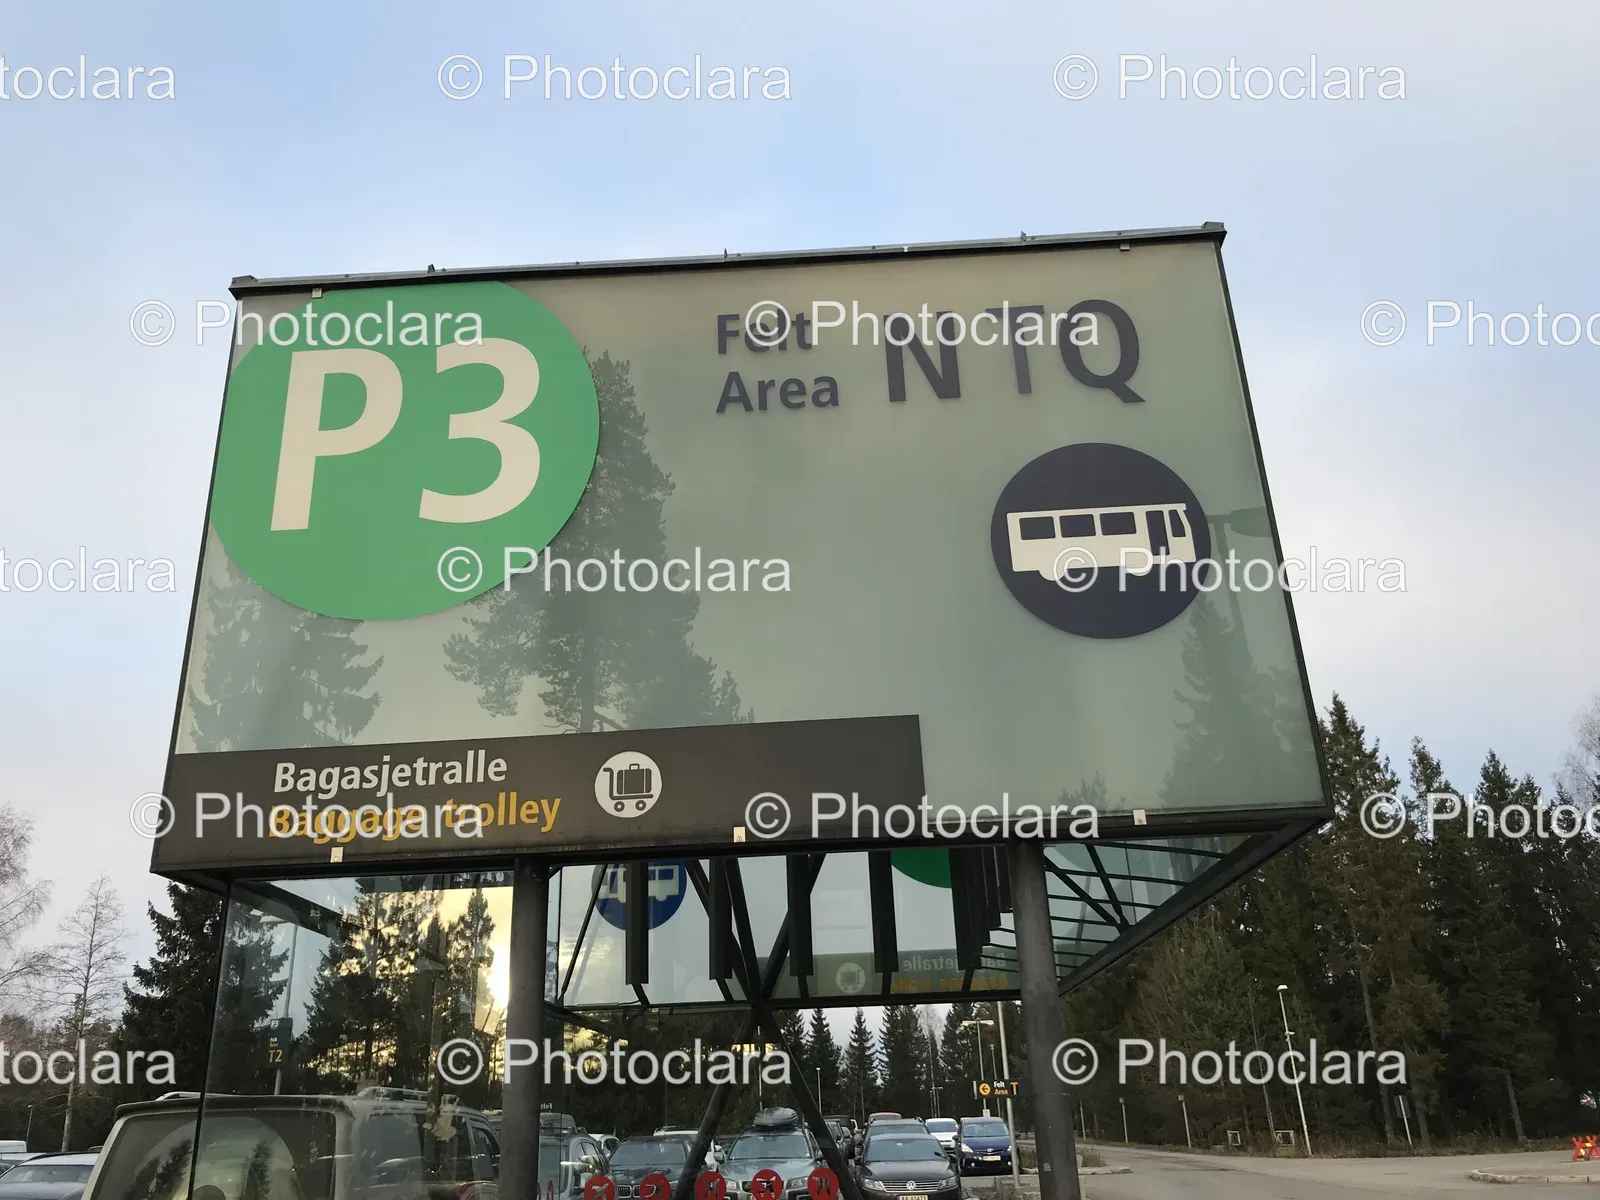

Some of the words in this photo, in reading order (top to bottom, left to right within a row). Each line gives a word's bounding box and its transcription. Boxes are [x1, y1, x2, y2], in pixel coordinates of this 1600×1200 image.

[717, 308, 813, 354] Felt
[716, 371, 839, 413] Area
[270, 337, 541, 532] P3
[274, 749, 507, 799] Bagasjetralle
[269, 805, 422, 843] Baggage
[445, 792, 561, 832] trolley
[268, 1049, 283, 1063] T2
